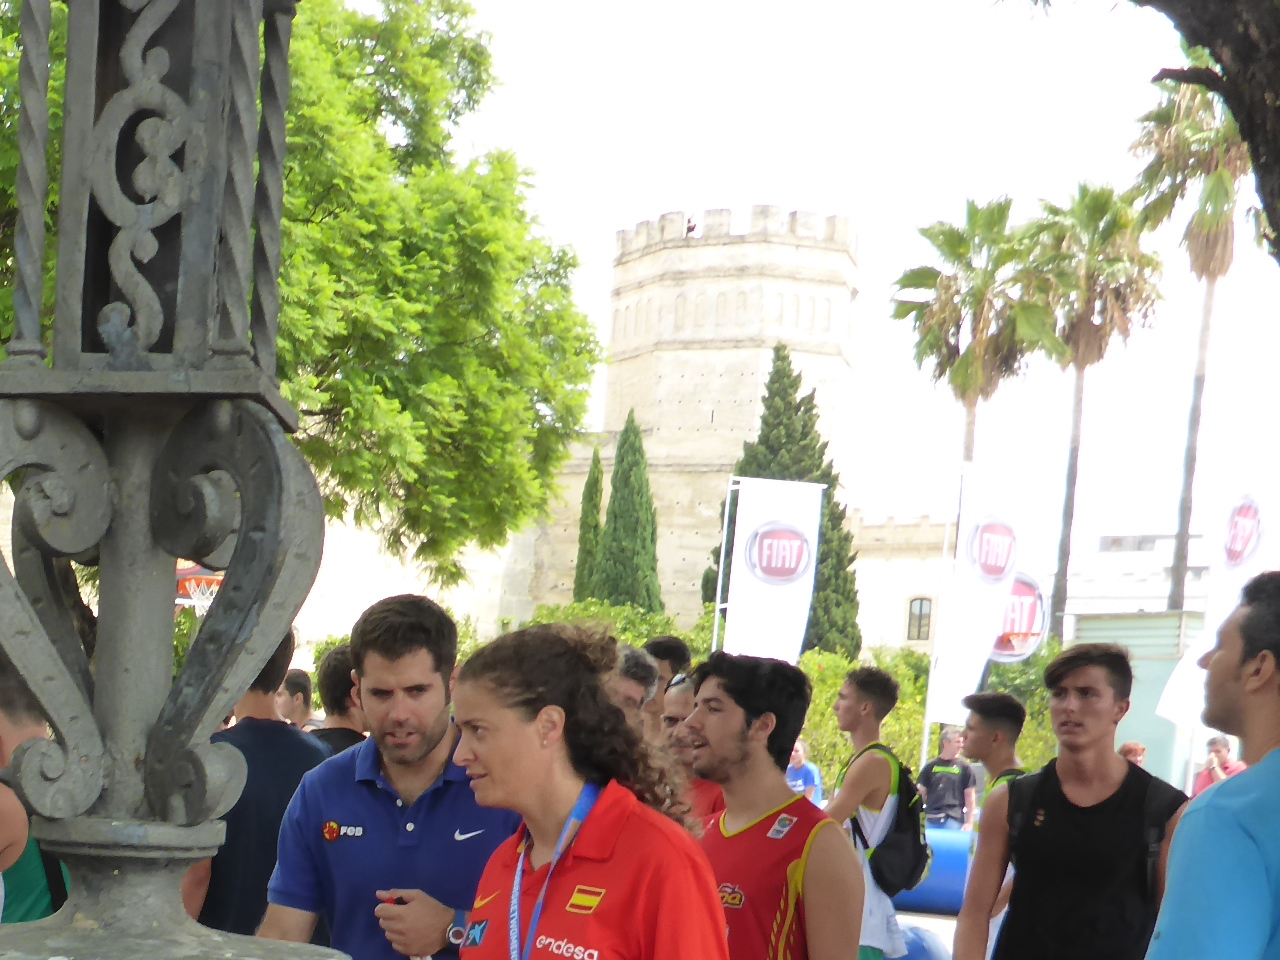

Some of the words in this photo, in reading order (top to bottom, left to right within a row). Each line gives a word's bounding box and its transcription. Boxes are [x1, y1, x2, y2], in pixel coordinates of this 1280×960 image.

[761, 538, 802, 569] FIAT
[980, 532, 1013, 568] FIAT
[1002, 594, 1035, 635] AT
